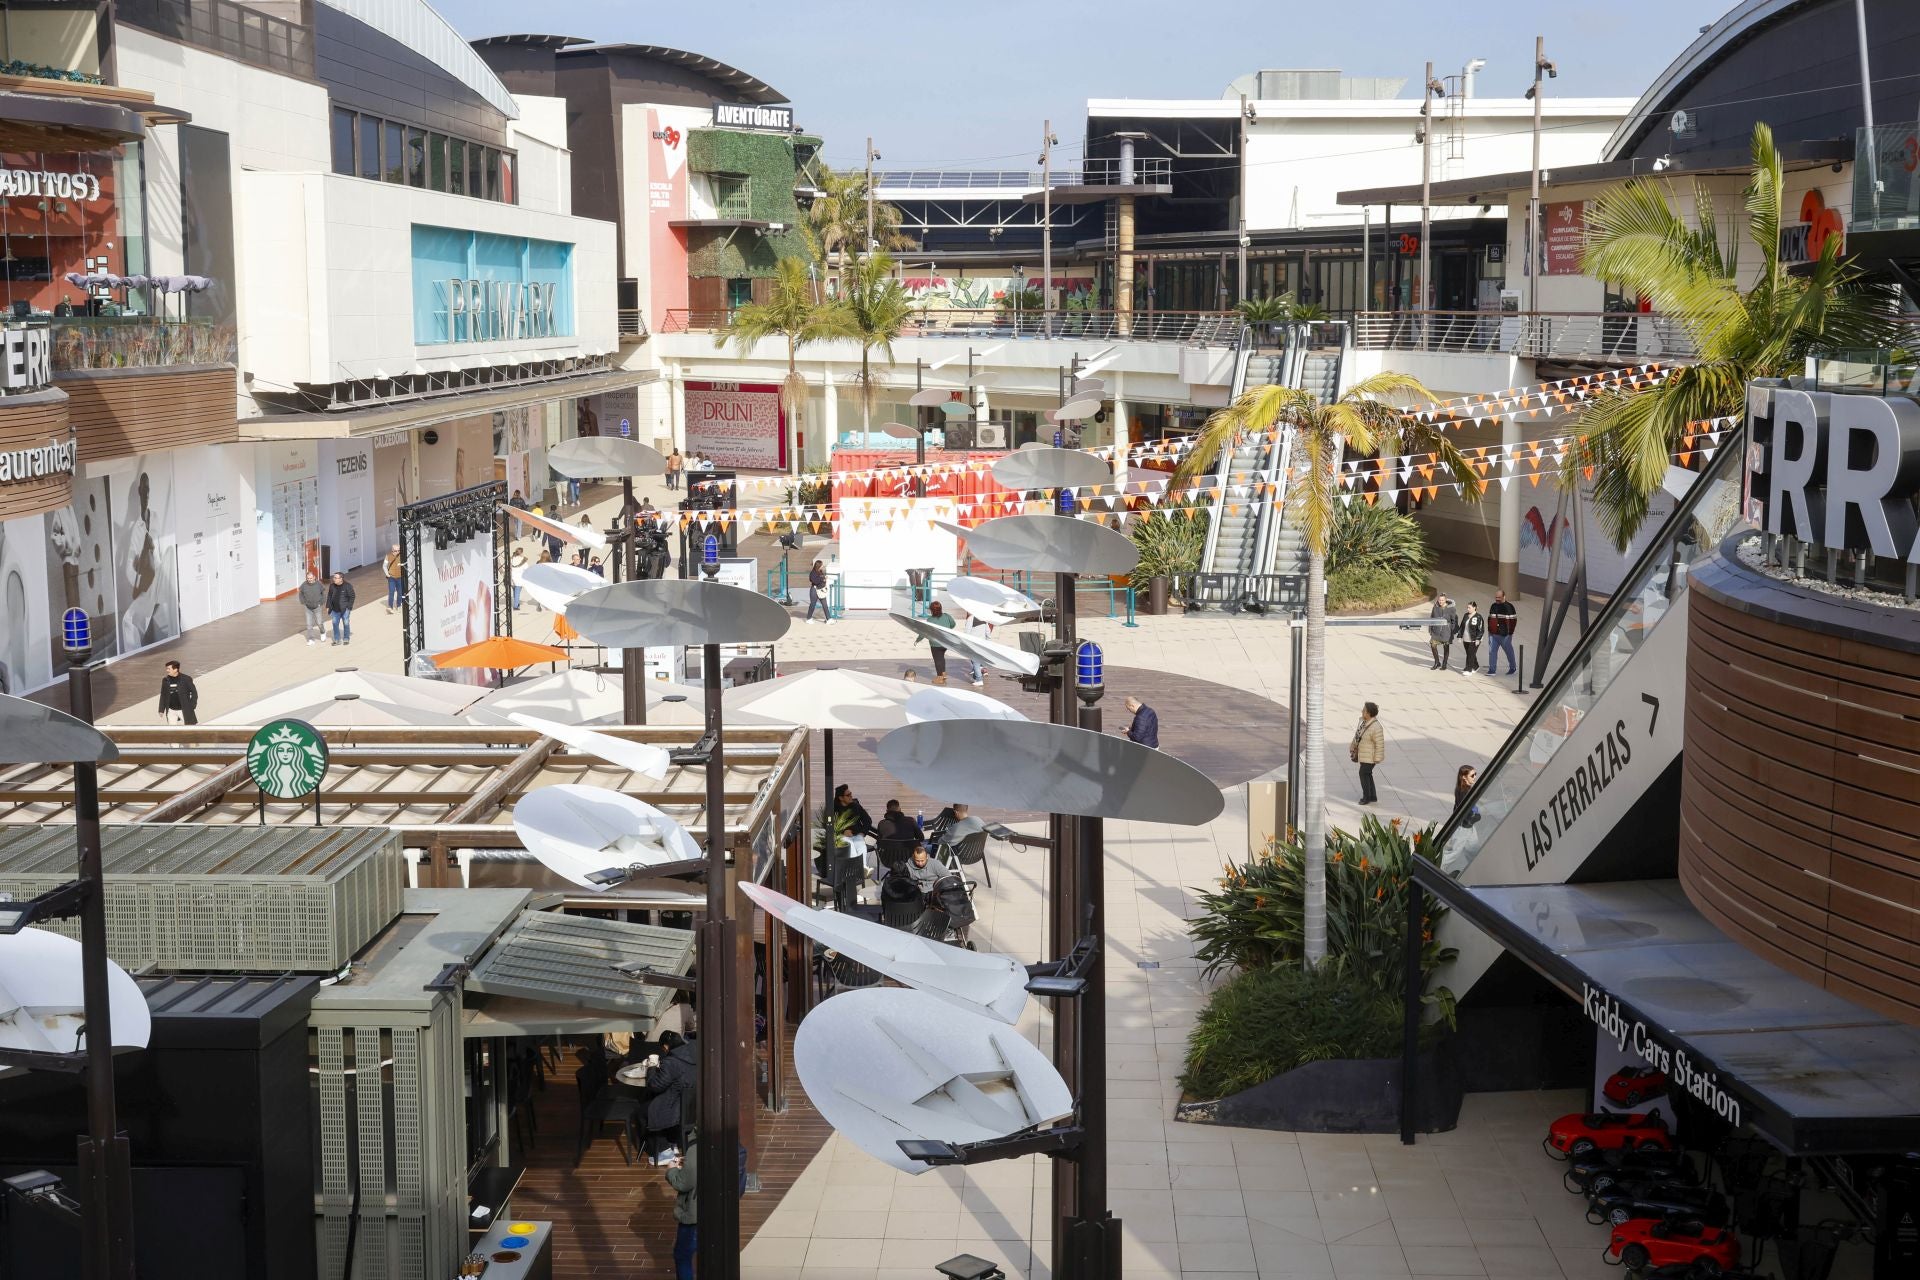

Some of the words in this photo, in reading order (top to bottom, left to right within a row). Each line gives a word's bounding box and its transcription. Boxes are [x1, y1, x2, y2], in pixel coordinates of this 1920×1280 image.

[717, 105, 789, 127] AVENTÚRATE
[448, 278, 557, 344] PRIMARK
[0, 328, 50, 389] ERR
[711, 382, 739, 392] DRUNI
[703, 402, 752, 422] DRUNI
[374, 430, 409, 449] CALZEDONIA
[1743, 386, 1920, 566] ERR
[1471, 617, 1478, 626] S
[1521, 809, 1552, 872] LAS
[1549, 719, 1631, 839] TERRAZAS
[1583, 982, 1630, 1052] Kiddy
[1633, 1021, 1670, 1075] Cars
[1674, 1050, 1740, 1128] Station
